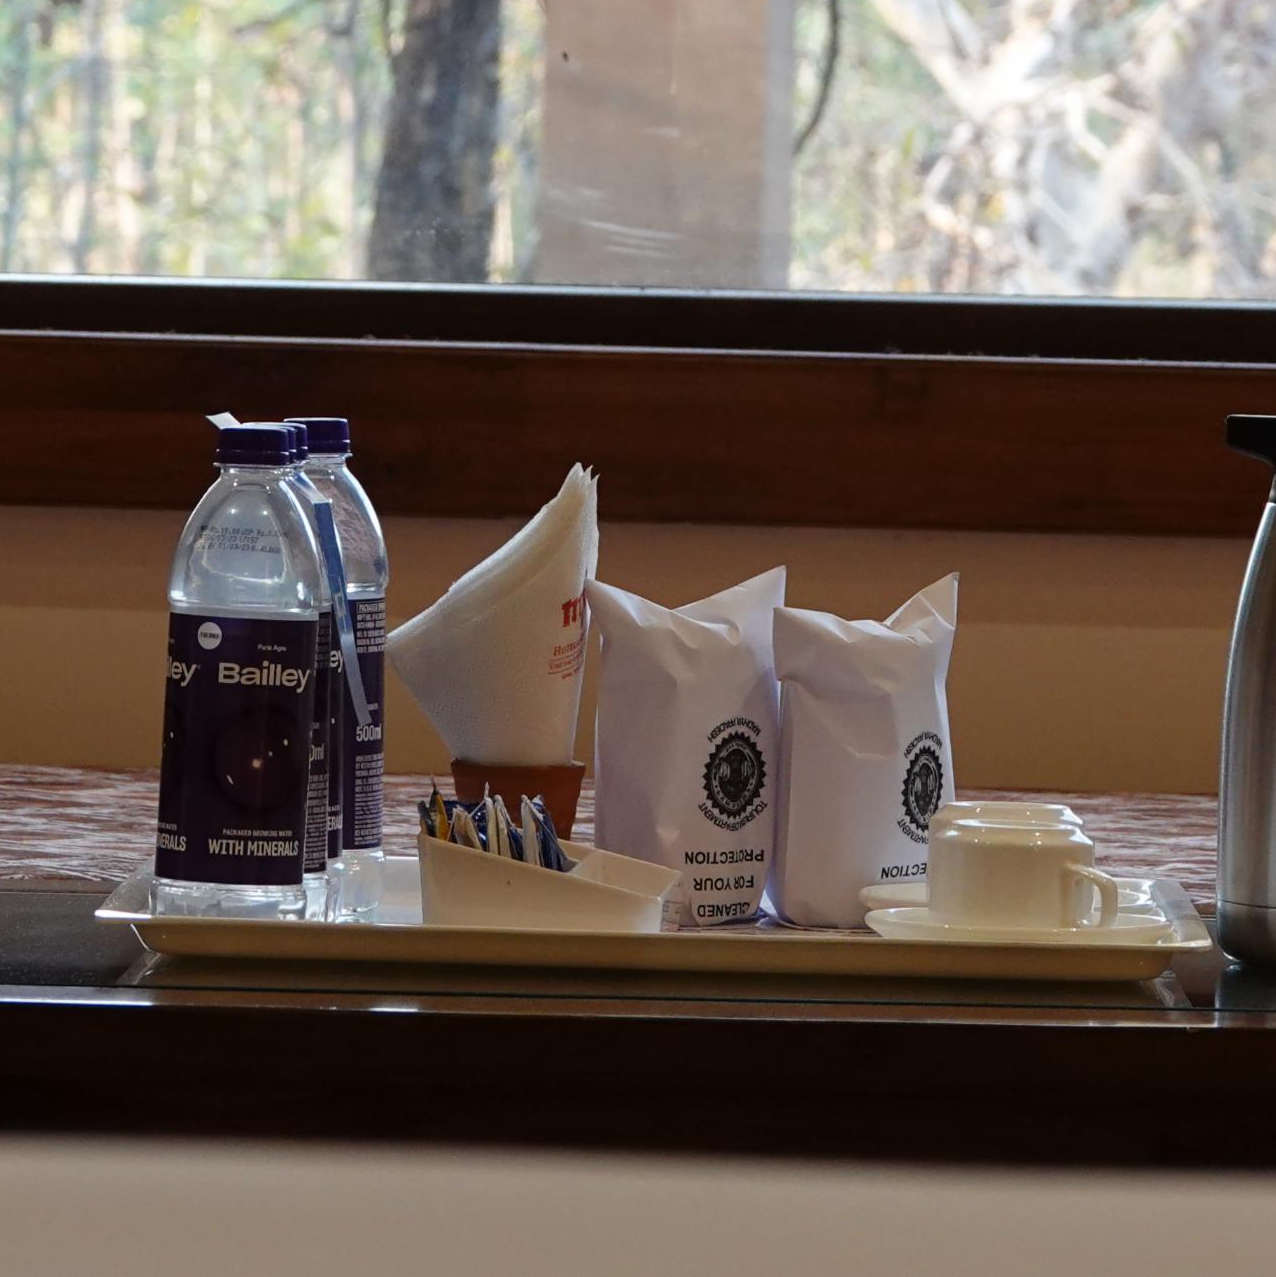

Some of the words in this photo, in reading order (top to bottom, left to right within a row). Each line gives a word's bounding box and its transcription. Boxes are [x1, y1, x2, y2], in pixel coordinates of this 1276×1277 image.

[218, 660, 310, 693] Bailley
[356, 723, 382, 742] 500ml
[208, 838, 244, 856] WITH
[247, 839, 299, 857] MINERALS
[685, 849, 765, 865] PROTECTION
[693, 877, 732, 892] YOUR
[734, 875, 754, 890] FOR
[697, 902, 751, 918] CLEANED
